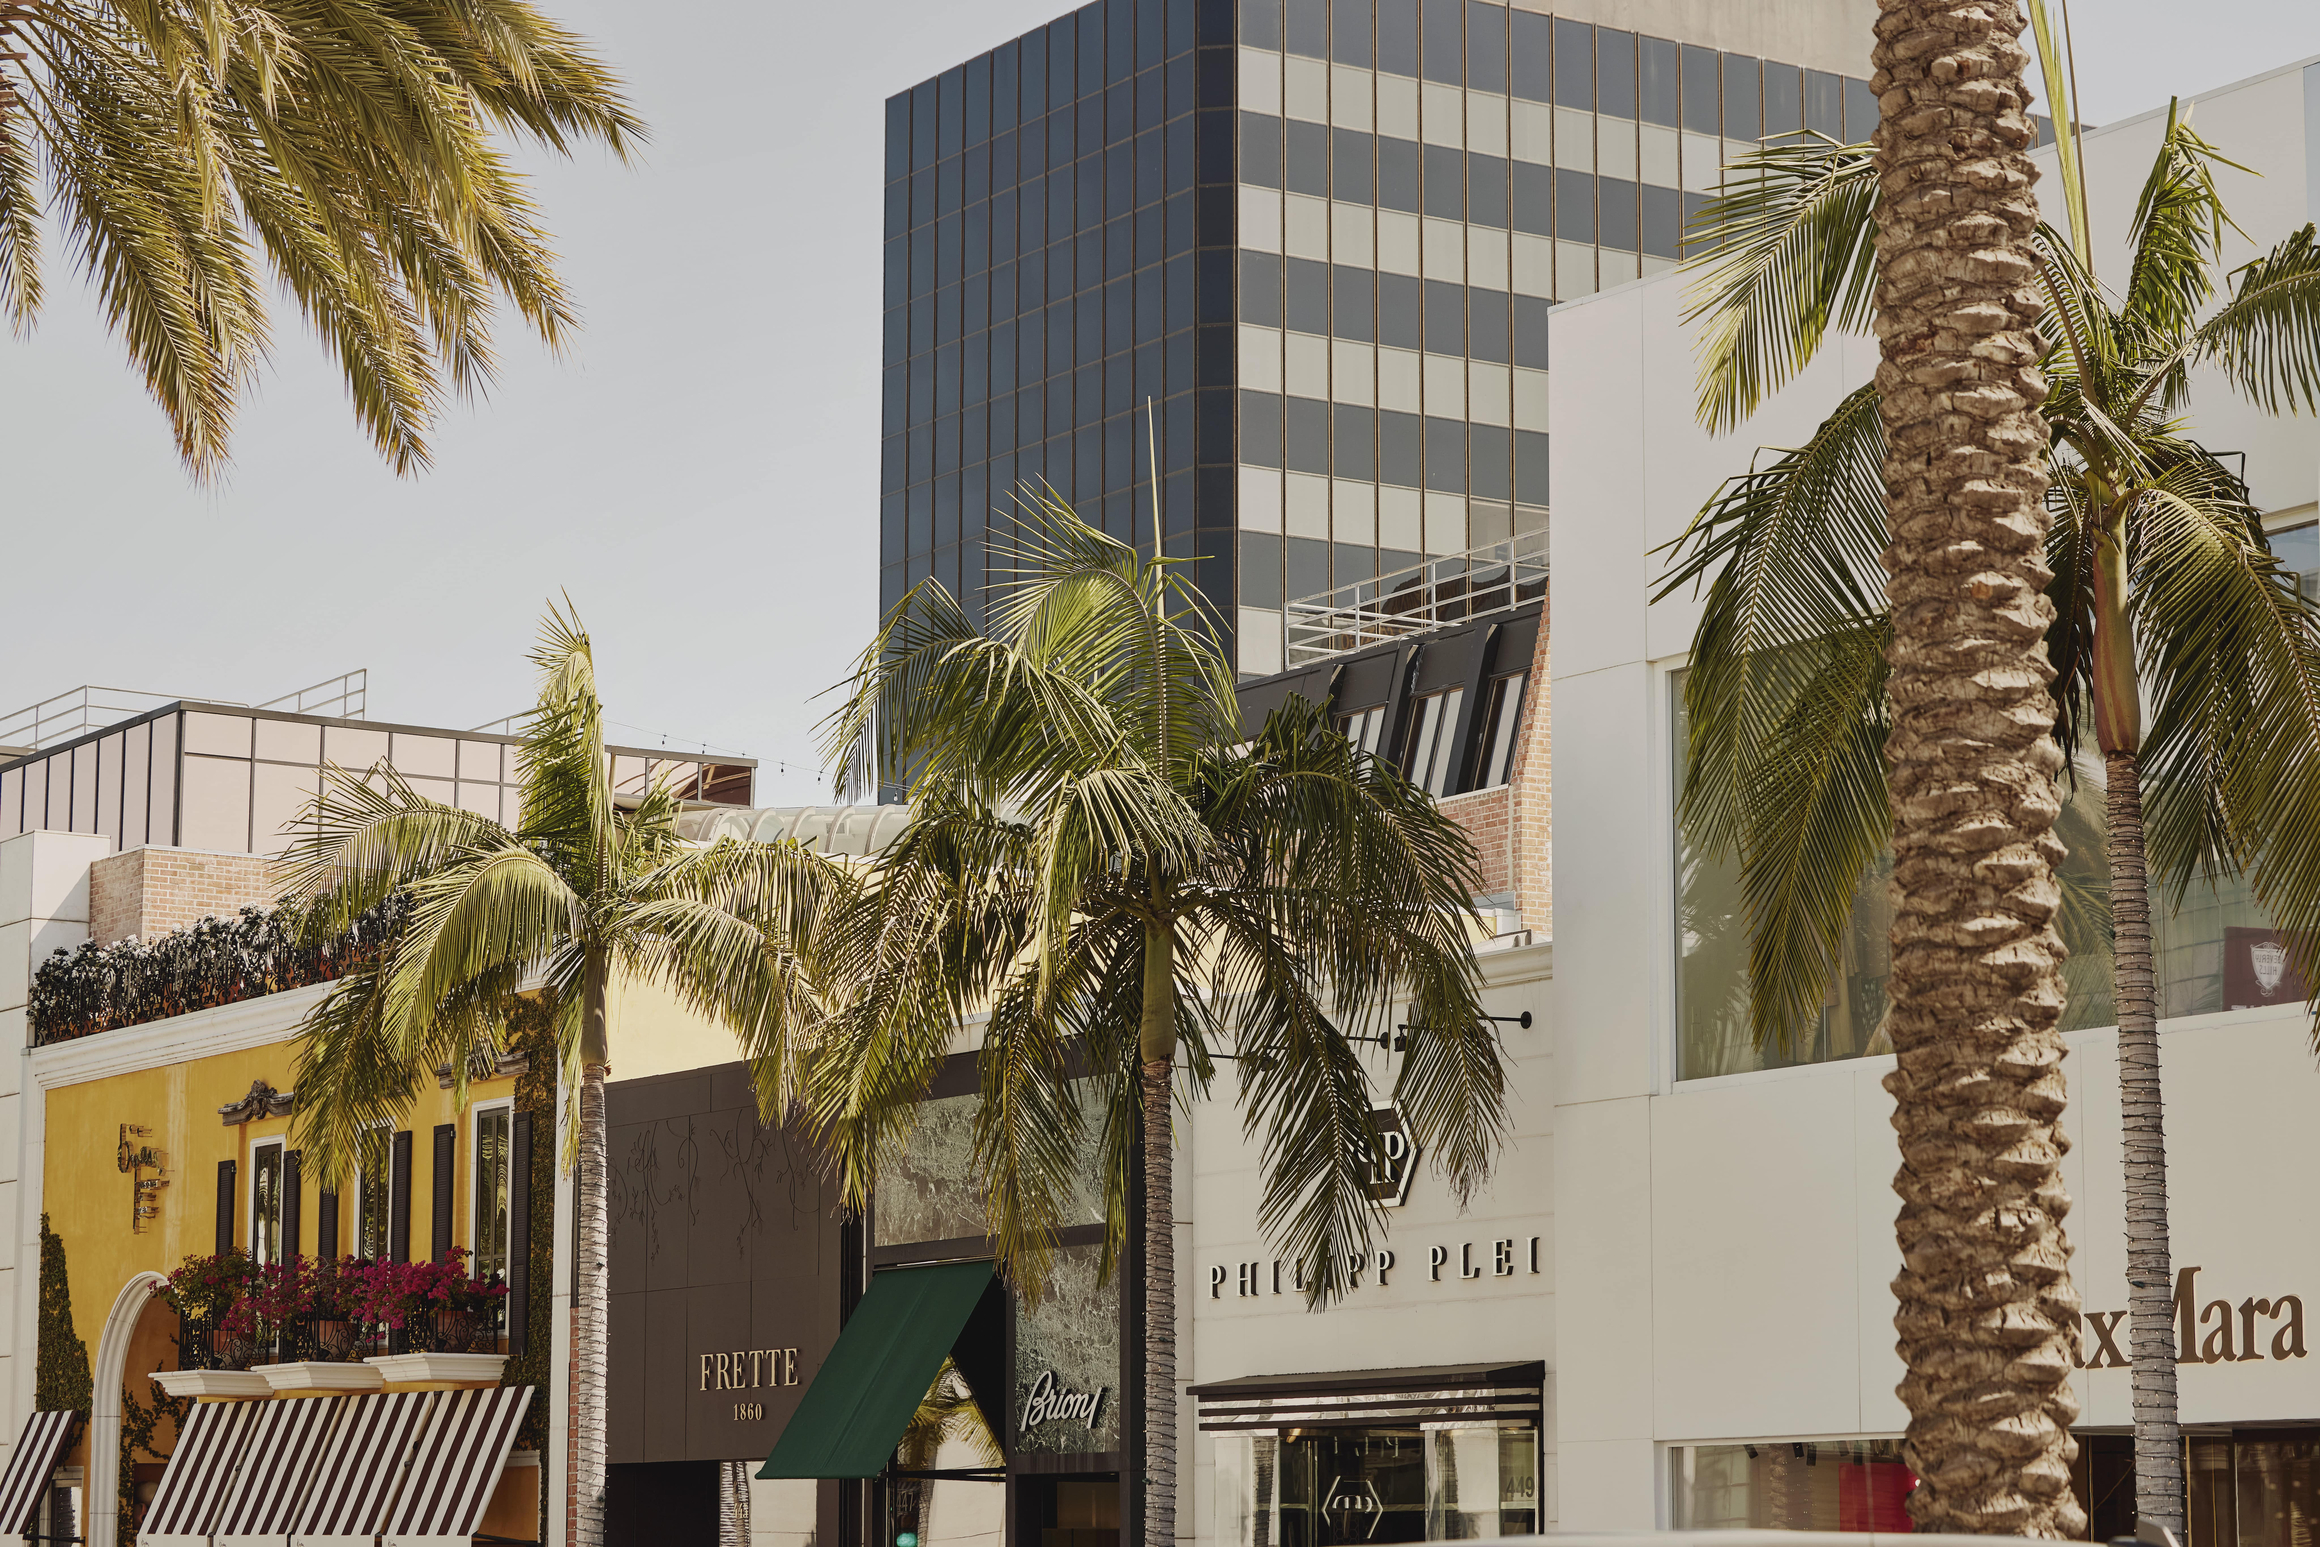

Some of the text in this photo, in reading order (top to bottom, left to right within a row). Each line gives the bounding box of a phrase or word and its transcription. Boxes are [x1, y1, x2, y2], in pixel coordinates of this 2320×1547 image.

[700, 1348, 798, 1391] FRETTE
[733, 1403, 762, 1421] 1860
[1506, 1476, 1534, 1498] 449
